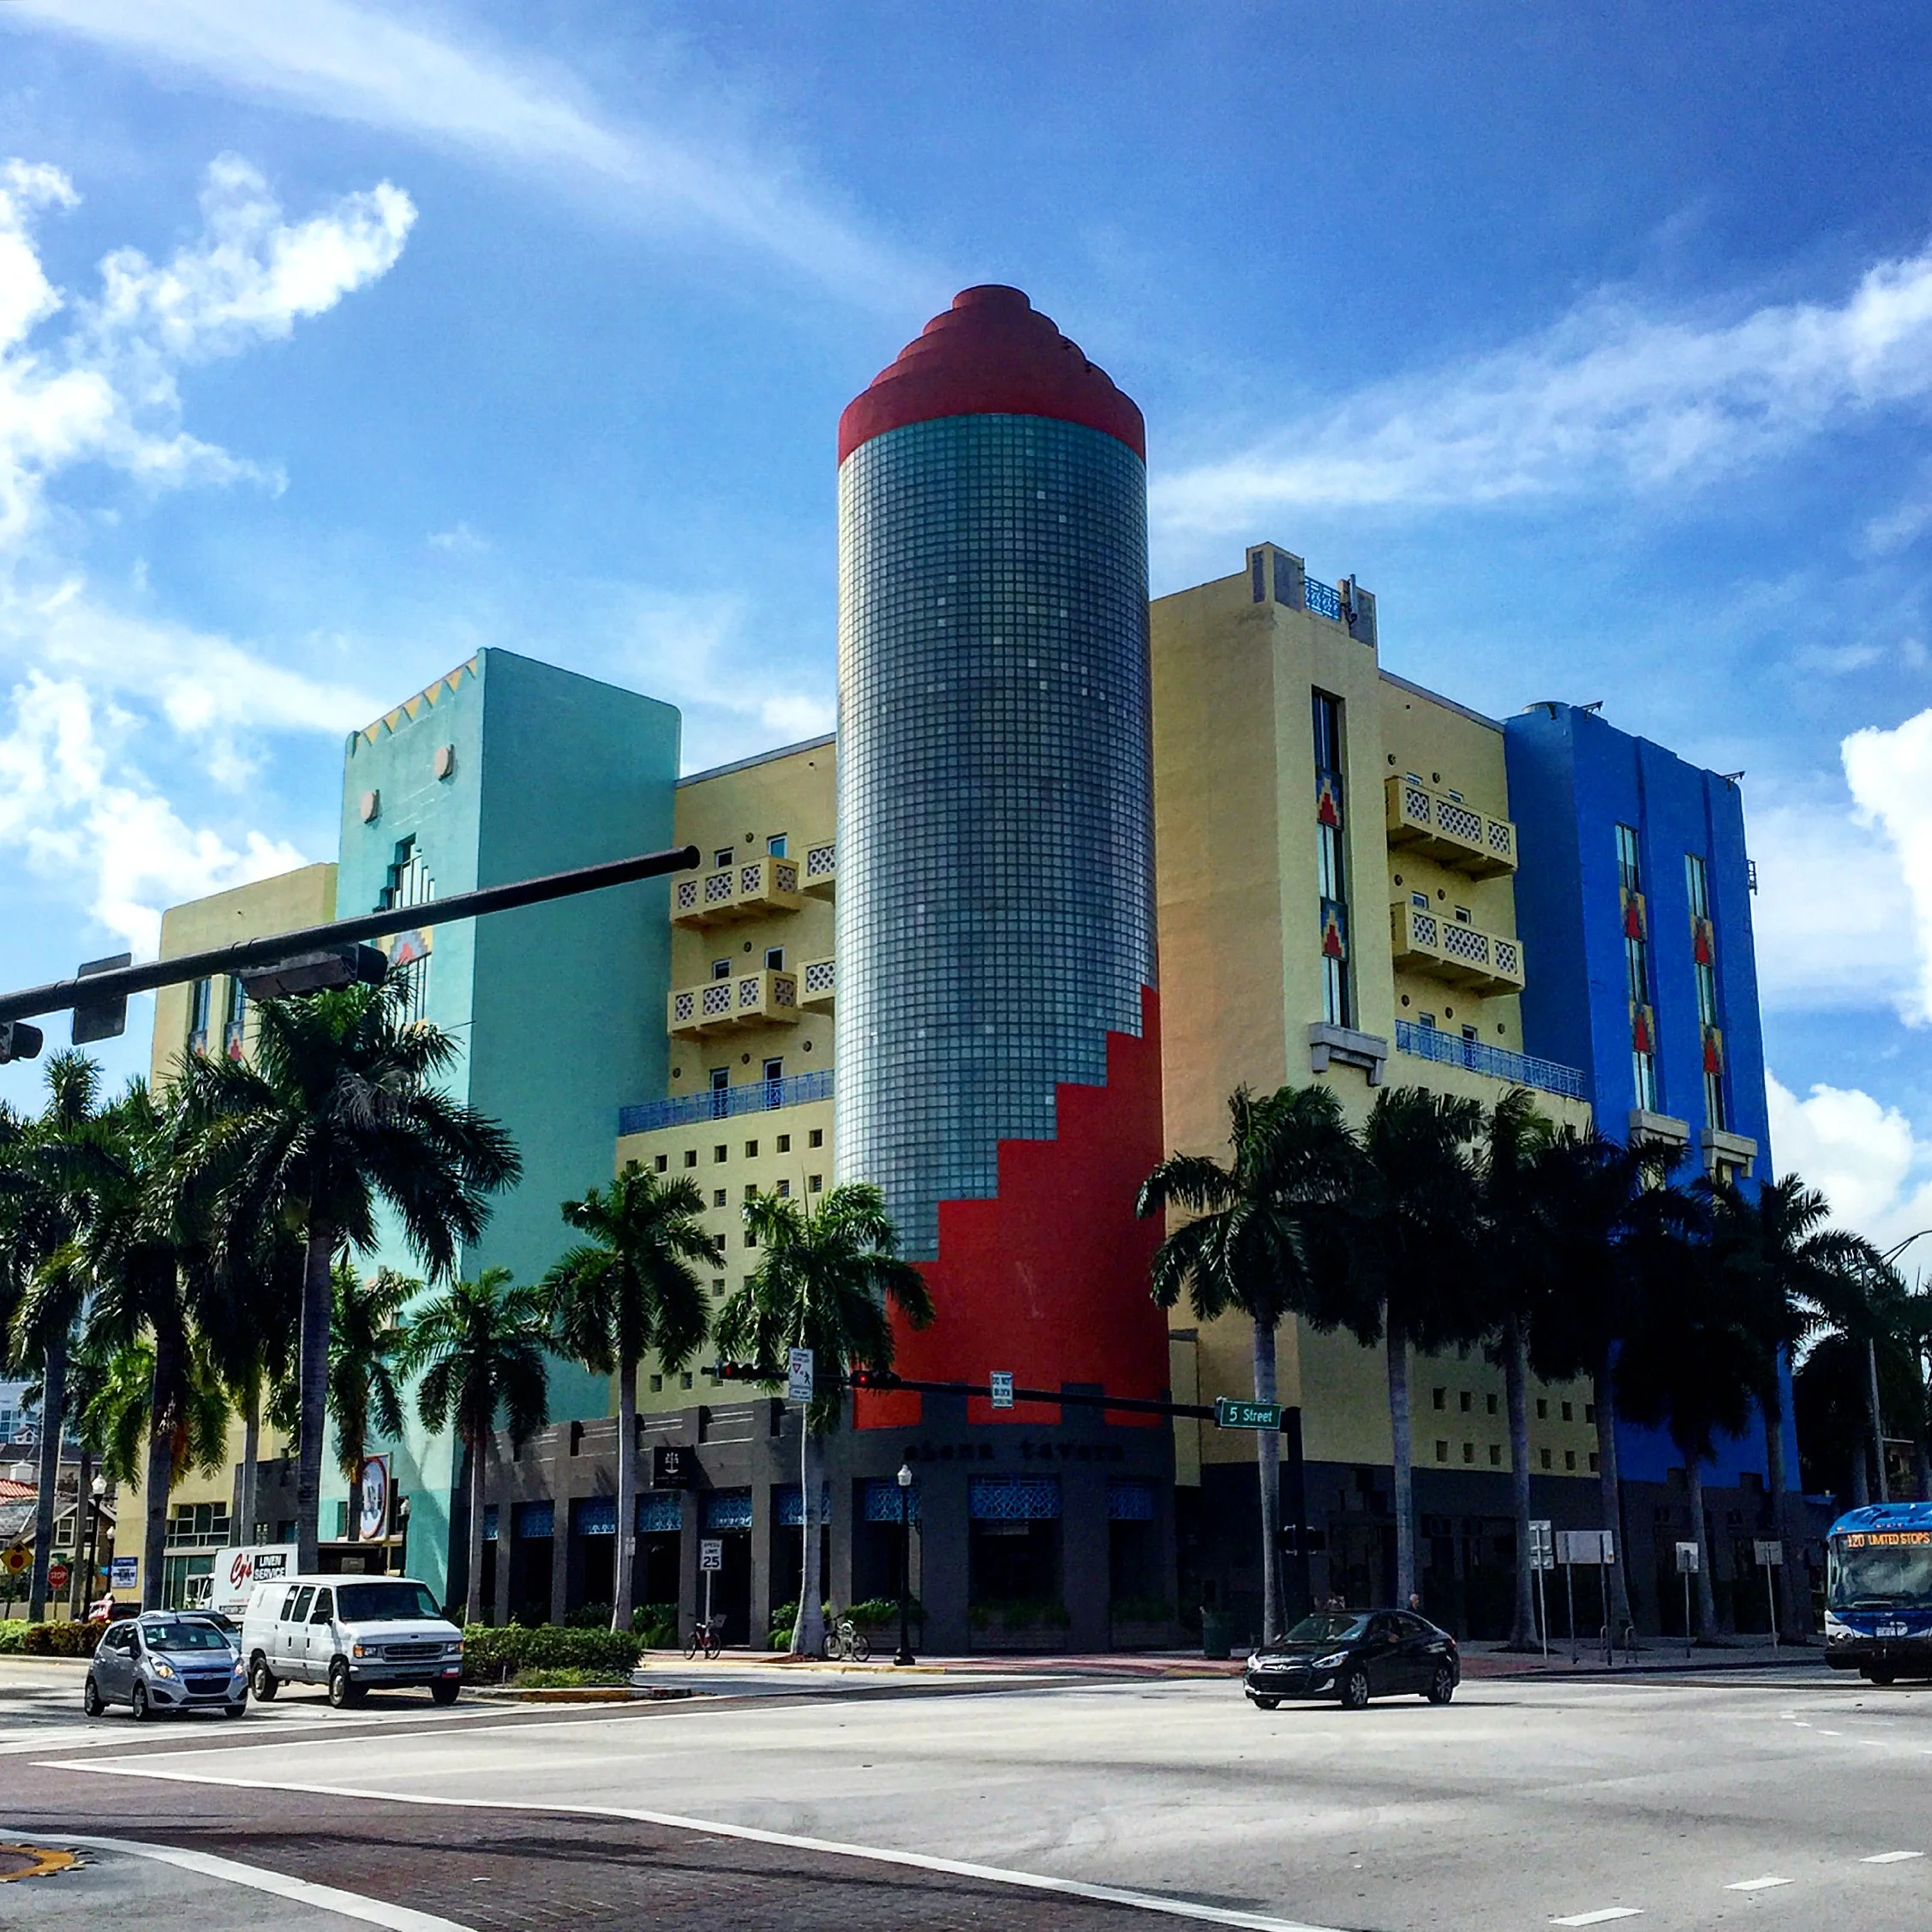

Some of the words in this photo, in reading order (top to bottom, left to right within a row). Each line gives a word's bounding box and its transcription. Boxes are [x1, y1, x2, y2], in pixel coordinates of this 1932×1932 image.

[1229, 1406, 1238, 1422] 5
[1243, 1408, 1273, 1423] Street
[1847, 1534, 1865, 1548] 120
[1868, 1533, 1899, 1546] LIMITED
[1899, 1531, 1930, 1545] STOPS
[259, 1554, 283, 1567] LINEN
[703, 1555, 720, 1568] 25
[254, 1566, 285, 1580] SERVICE
